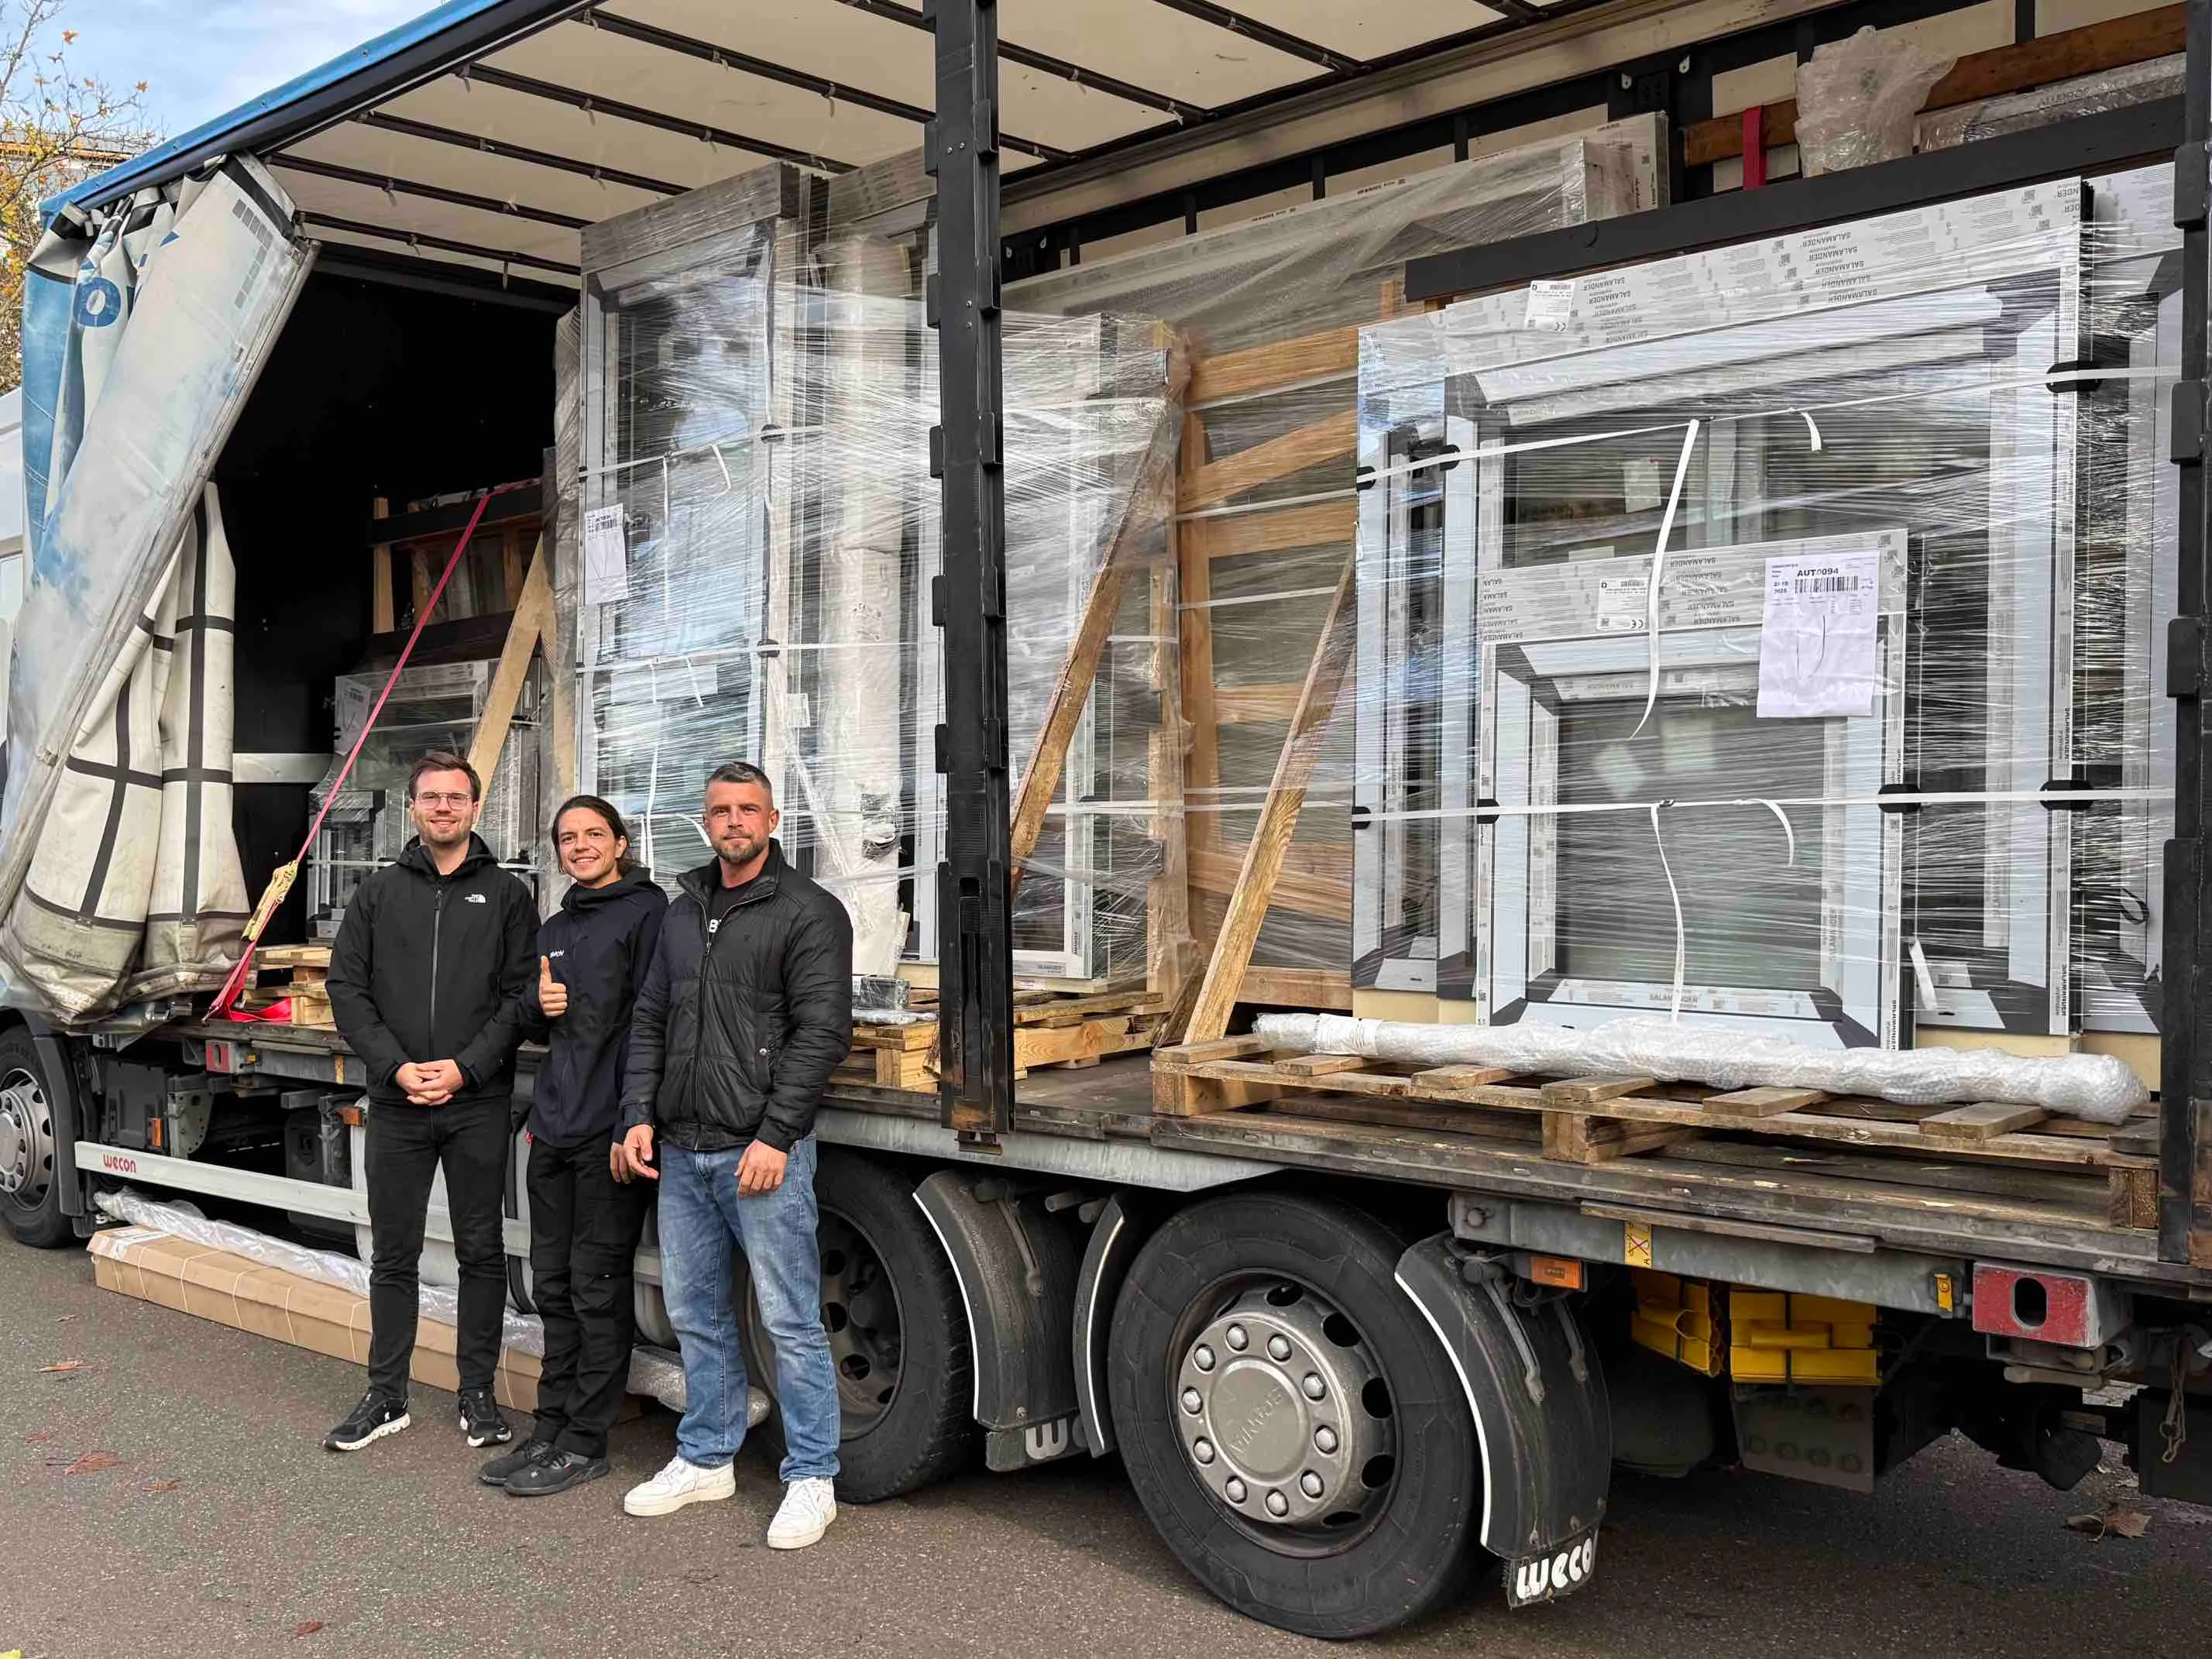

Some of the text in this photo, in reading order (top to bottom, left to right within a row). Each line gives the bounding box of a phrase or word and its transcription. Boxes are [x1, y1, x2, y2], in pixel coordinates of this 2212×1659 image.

[1808, 246, 1858, 261] SALAMANDER
[1815, 260, 1864, 274] SALAMANDER
[103, 1152, 136, 1173] wecon
